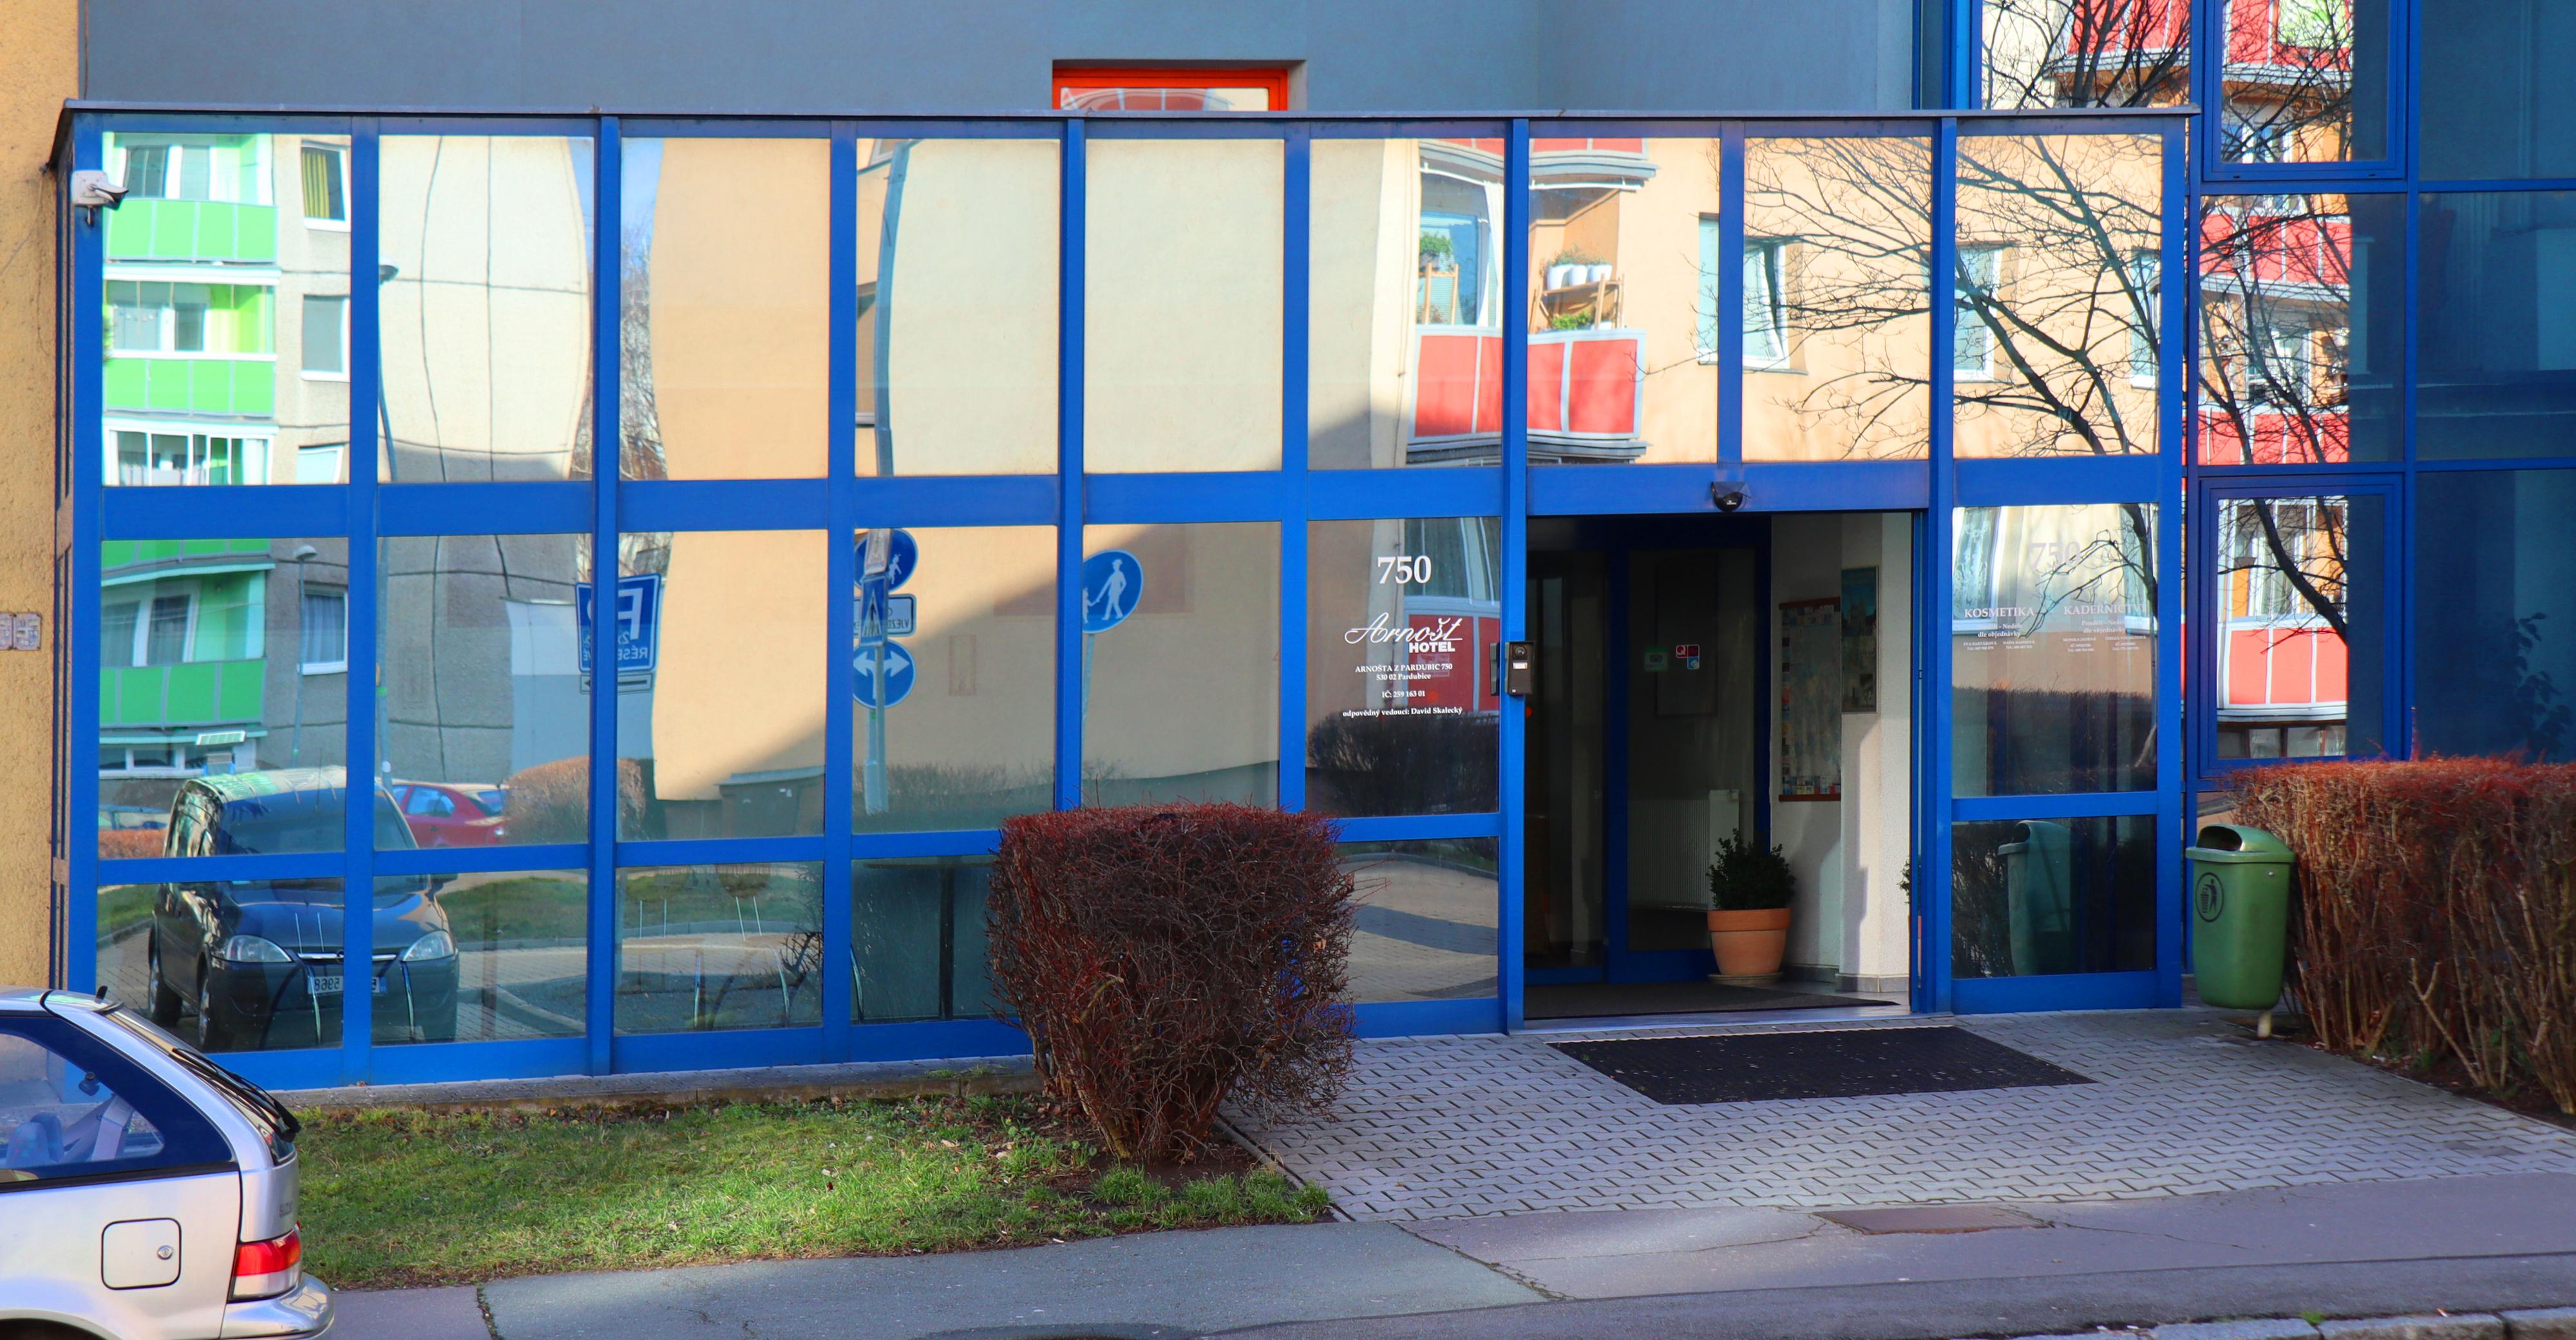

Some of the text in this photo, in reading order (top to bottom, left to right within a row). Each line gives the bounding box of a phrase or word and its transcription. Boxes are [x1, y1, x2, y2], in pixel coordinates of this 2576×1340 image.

[1378, 555, 1432, 584] 750
[1964, 607, 2034, 618] KOSMETIKA
[1344, 612, 1463, 644] Arnošt
[1408, 641, 1455, 653] HOTEL
[1355, 664, 1392, 673] ARNOŠTA
[1401, 663, 1441, 671] PARDUBIC
[1342, 709, 1380, 718] odpovědný
[1381, 708, 1410, 716] vedoucí:
[1432, 706, 1463, 715] Skalecký
